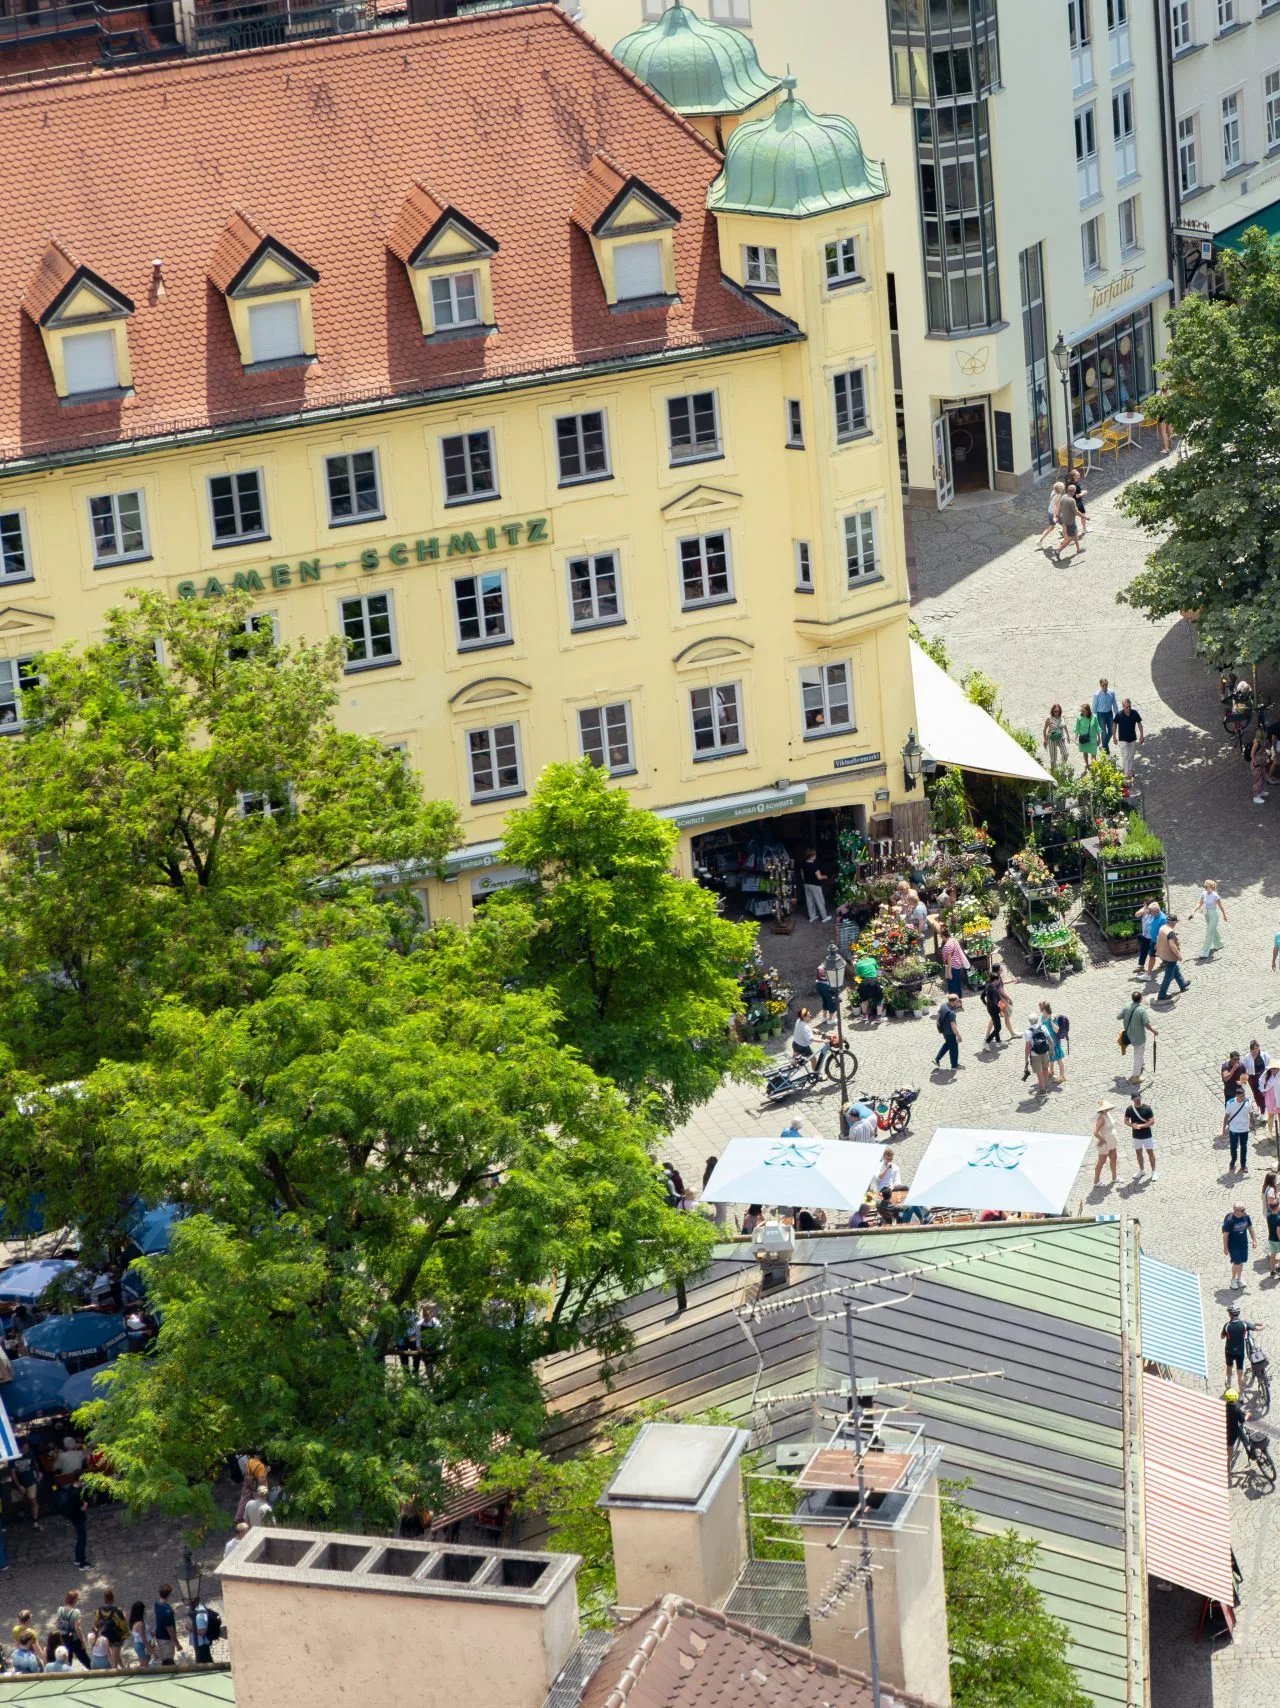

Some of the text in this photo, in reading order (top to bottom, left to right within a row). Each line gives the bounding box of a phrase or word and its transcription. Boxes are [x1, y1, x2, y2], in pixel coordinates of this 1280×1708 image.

[1092, 273, 1134, 312] farfalla
[177, 517, 549, 600] SAMEN-SCHMITZ
[68, 1348, 97, 1357] PAULANER
